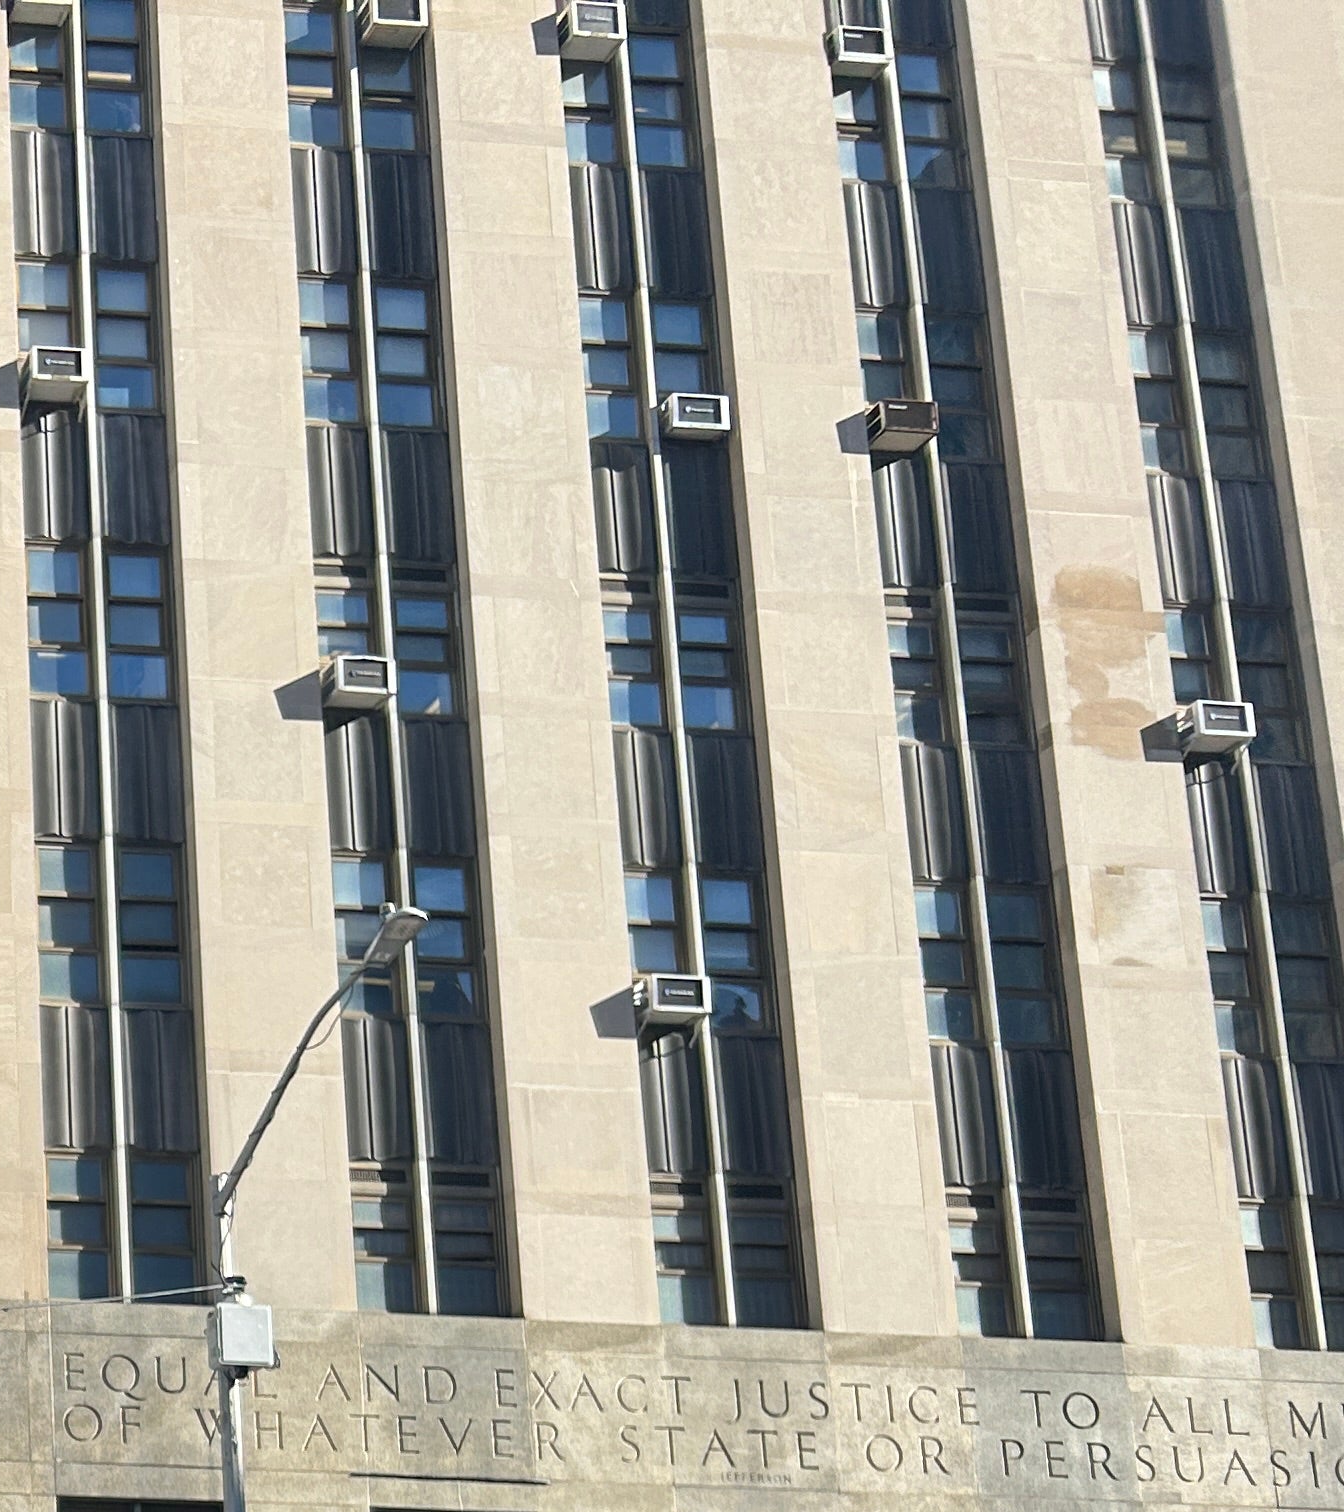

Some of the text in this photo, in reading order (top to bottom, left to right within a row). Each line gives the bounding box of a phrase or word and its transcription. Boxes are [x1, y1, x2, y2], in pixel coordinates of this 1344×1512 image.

[317, 1362, 458, 1405] AND
[495, 1368, 693, 1416] EXACT
[727, 1378, 981, 1427] JUSTICE
[1019, 1389, 1102, 1431] TO
[1142, 1396, 1251, 1437] ALL
[1288, 1400, 1344, 1441] M
[62, 1404, 142, 1445] OF
[194, 1406, 566, 1463] WHATEVER
[620, 1424, 820, 1473] STATE
[864, 1434, 952, 1478] OR
